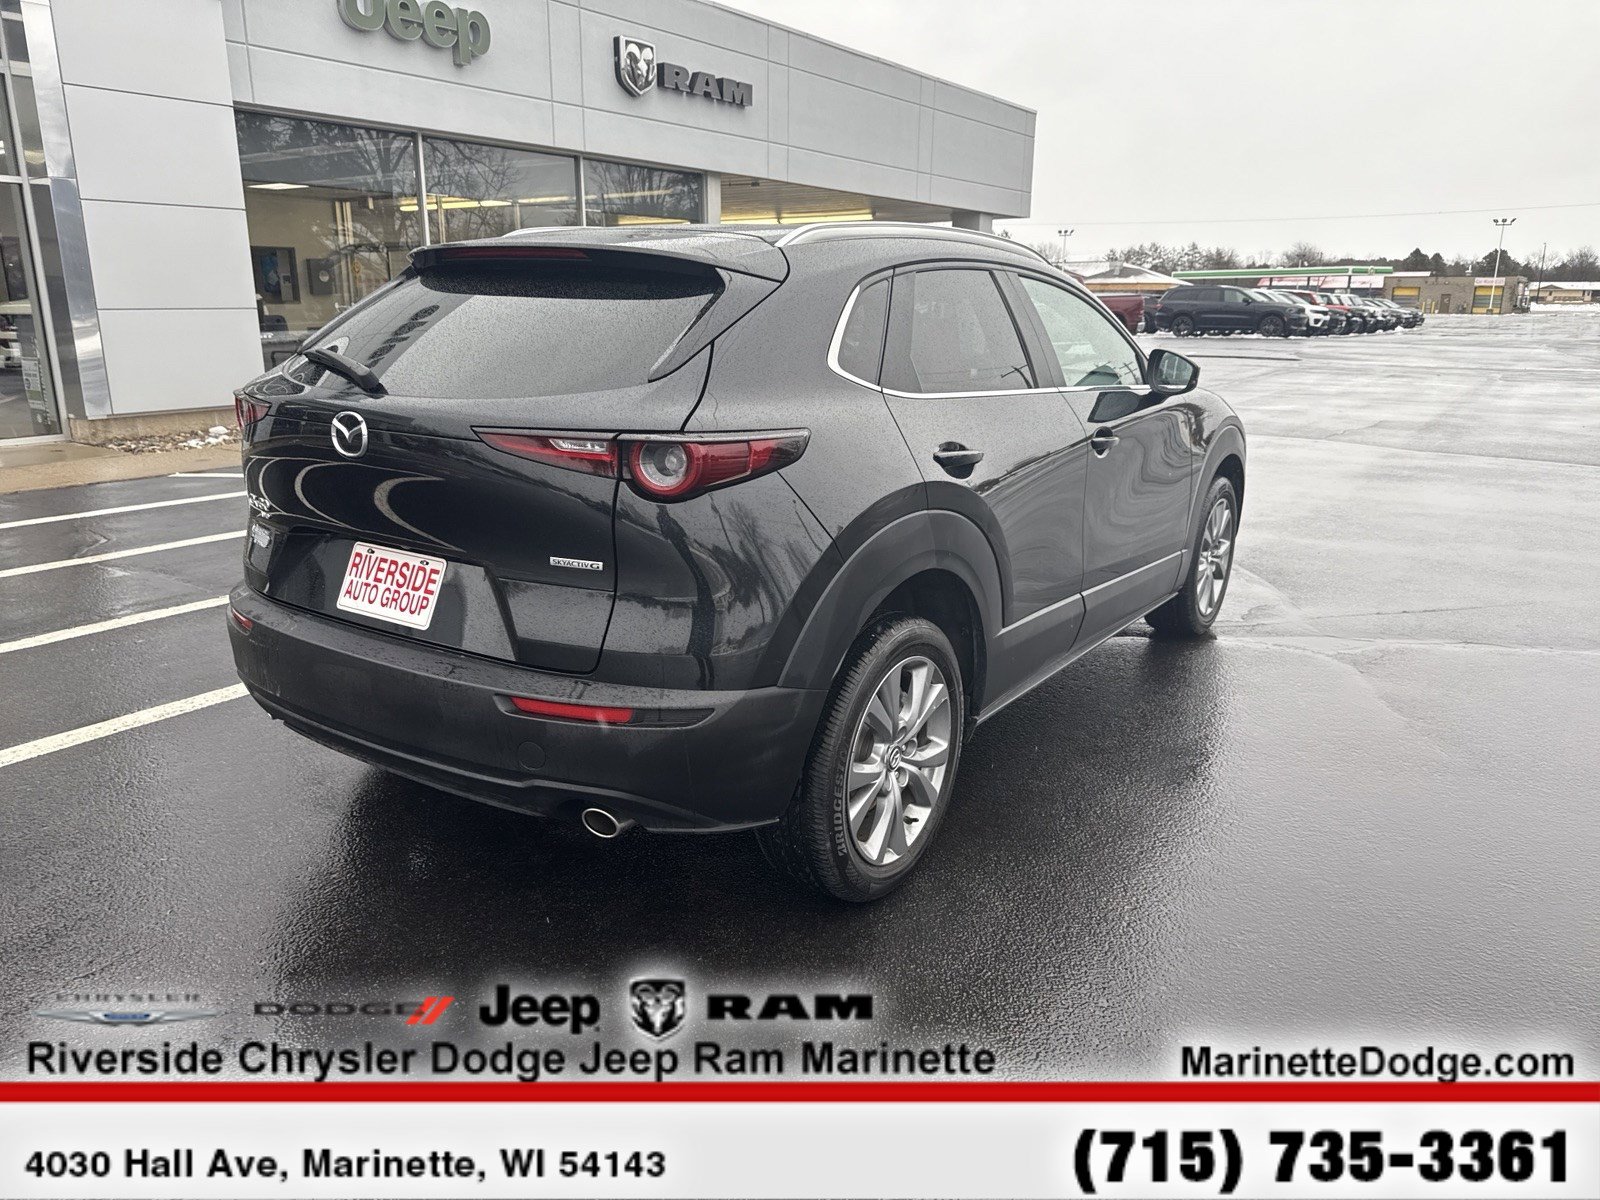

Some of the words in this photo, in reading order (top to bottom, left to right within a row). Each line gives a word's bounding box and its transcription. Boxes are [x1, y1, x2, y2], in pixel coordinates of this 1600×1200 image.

[657, 62, 753, 106] RAM
[349, 552, 440, 596] RIVERSIDE
[343, 579, 379, 604] AUTO
[380, 587, 430, 616] GROUP
